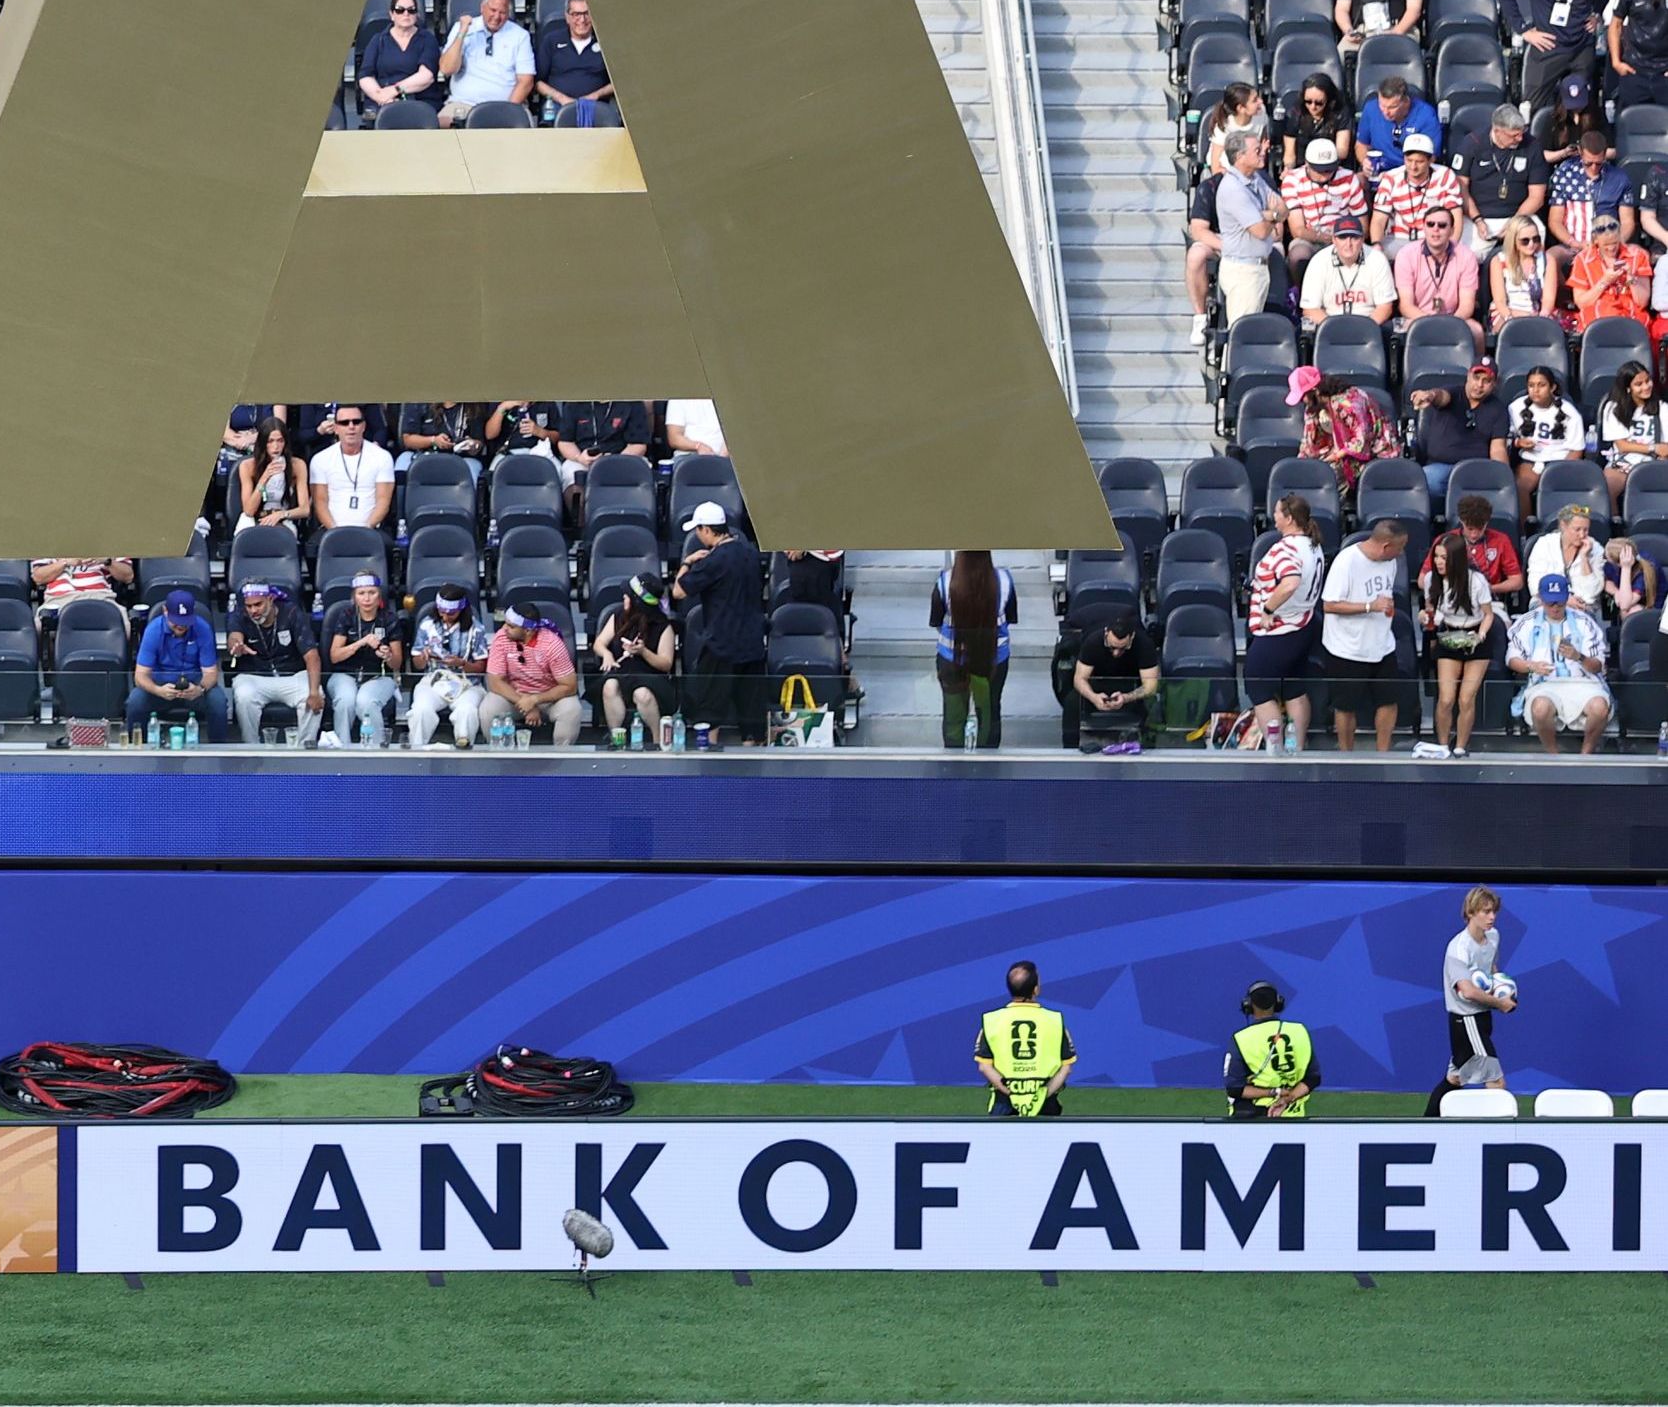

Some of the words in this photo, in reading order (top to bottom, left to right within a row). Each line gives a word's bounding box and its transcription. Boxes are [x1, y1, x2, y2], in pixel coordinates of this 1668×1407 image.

[1335, 291, 1368, 306] USA
[1630, 418, 1655, 437] SA
[1364, 576, 1395, 597] USA
[158, 1143, 667, 1251] BANK
[738, 1138, 971, 1253] OF
[1028, 1141, 1642, 1252] AMERI
